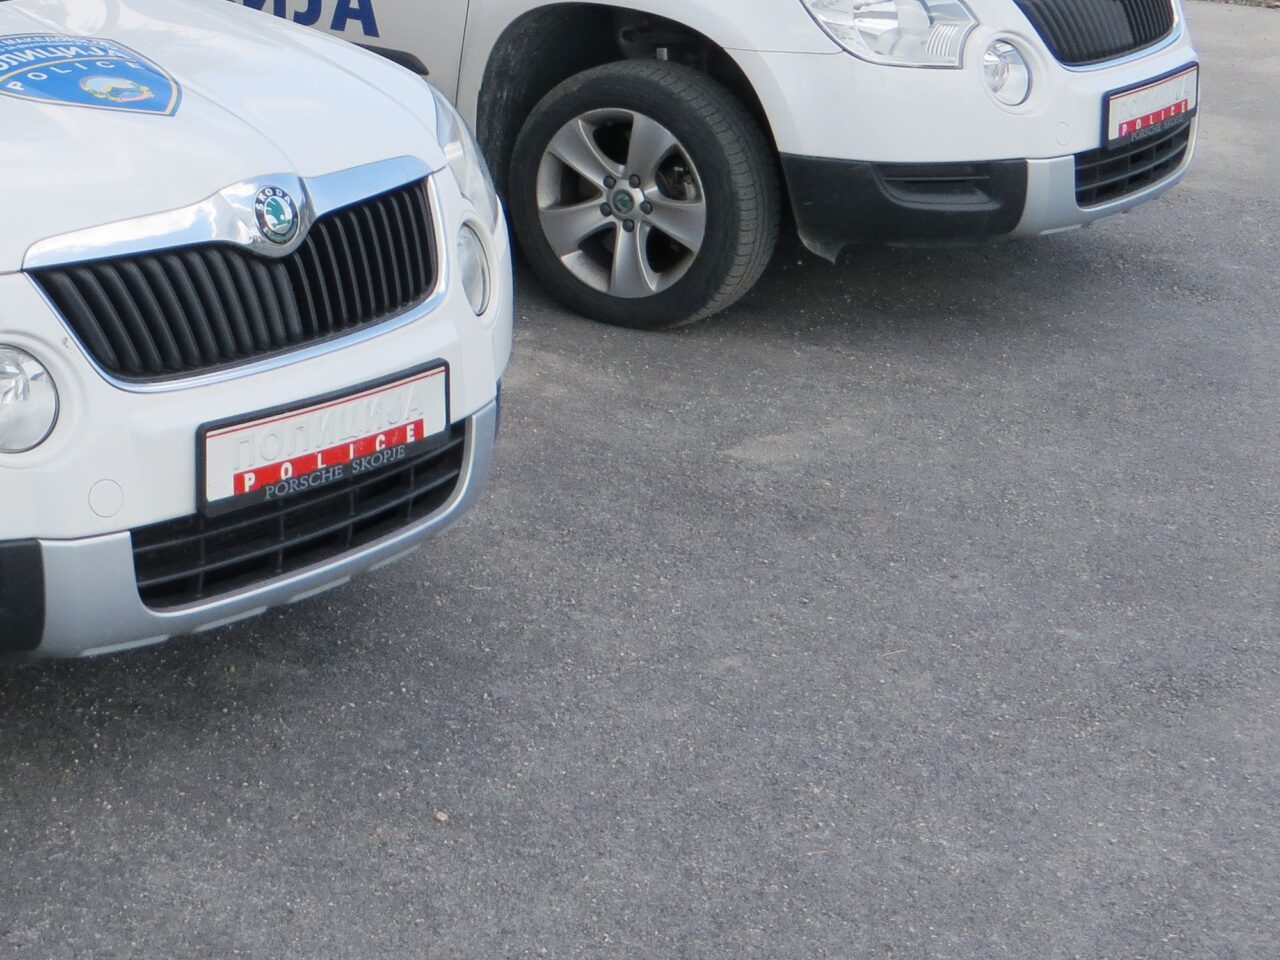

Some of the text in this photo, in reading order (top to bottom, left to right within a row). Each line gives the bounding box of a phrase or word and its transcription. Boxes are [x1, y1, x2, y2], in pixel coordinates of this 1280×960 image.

[6, 59, 143, 91] POLICE
[1121, 100, 1187, 137] POLICE
[243, 422, 416, 493] POLICE
[265, 444, 407, 500] PORSCHE SKOPJE
